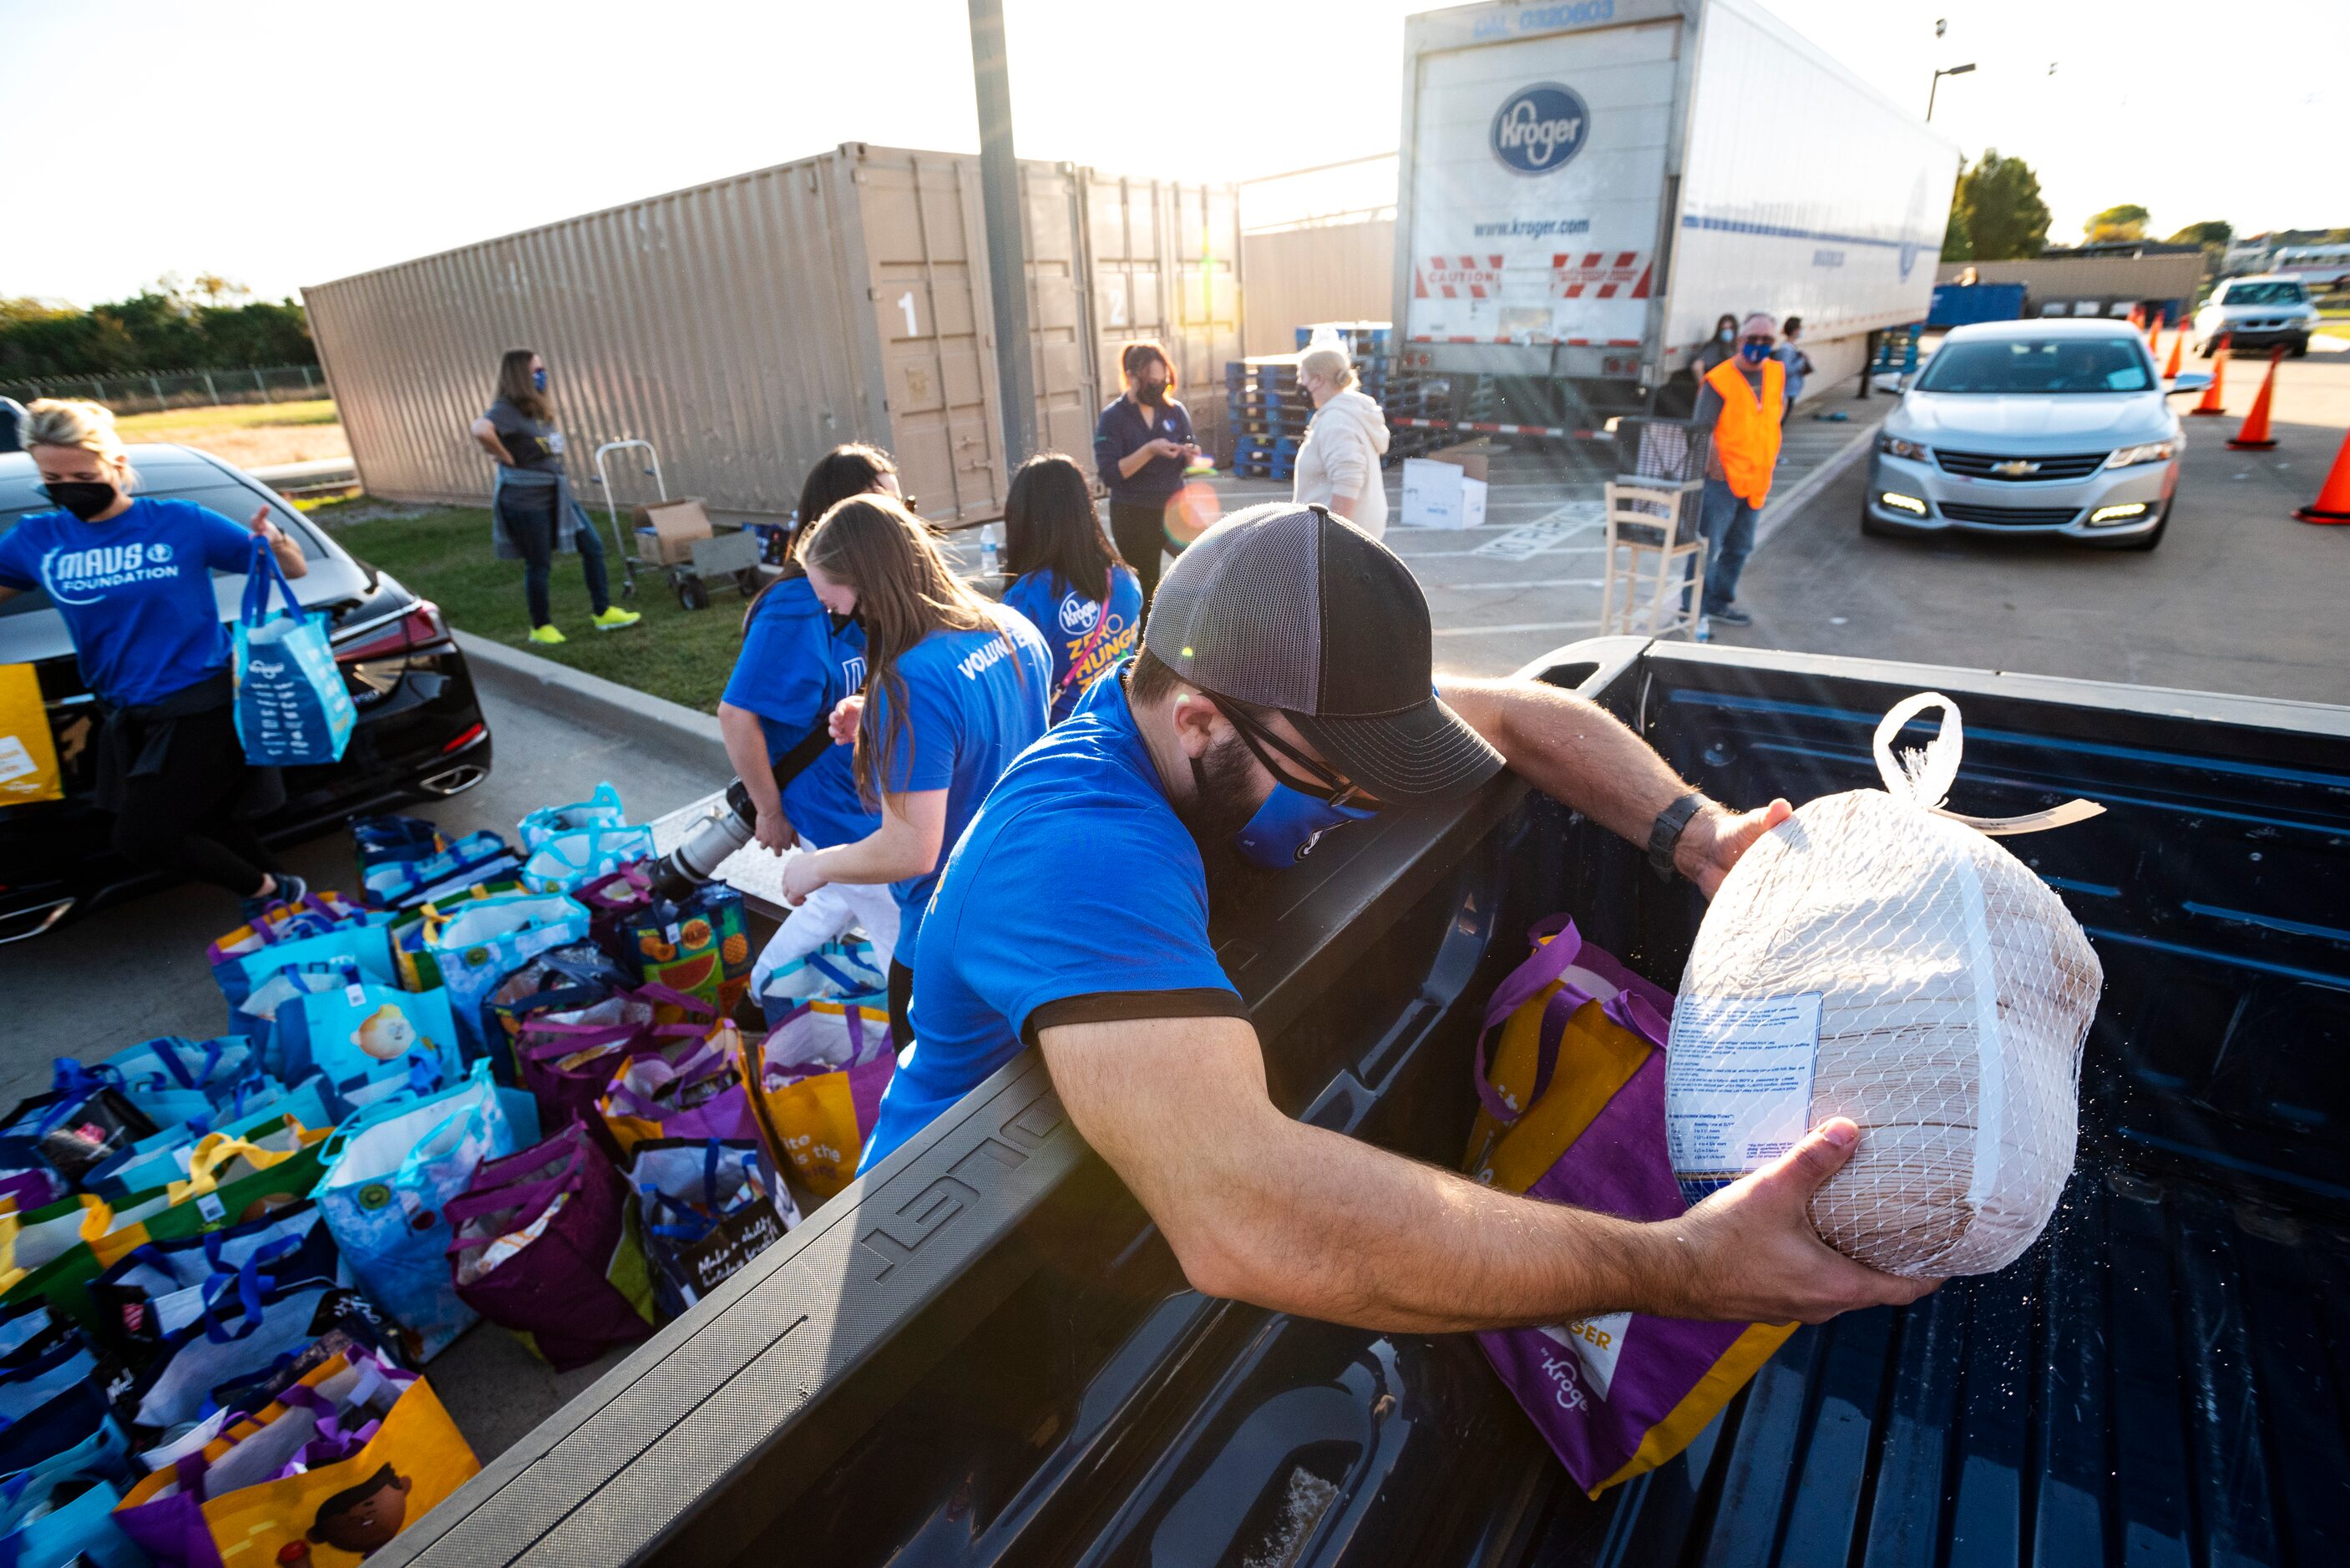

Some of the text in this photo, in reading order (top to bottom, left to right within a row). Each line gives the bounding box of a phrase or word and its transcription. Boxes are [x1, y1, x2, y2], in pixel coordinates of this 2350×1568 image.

[1500, 99, 1582, 166] Kroger
[1474, 217, 1590, 241] www.kroger.com
[897, 291, 918, 337] 1
[1108, 289, 1126, 326] 2
[56, 543, 144, 580] MAVS
[61, 565, 179, 593] FOUNDATION
[812, 1143, 841, 1163] the
[1541, 1357, 1589, 1412] Kroge
